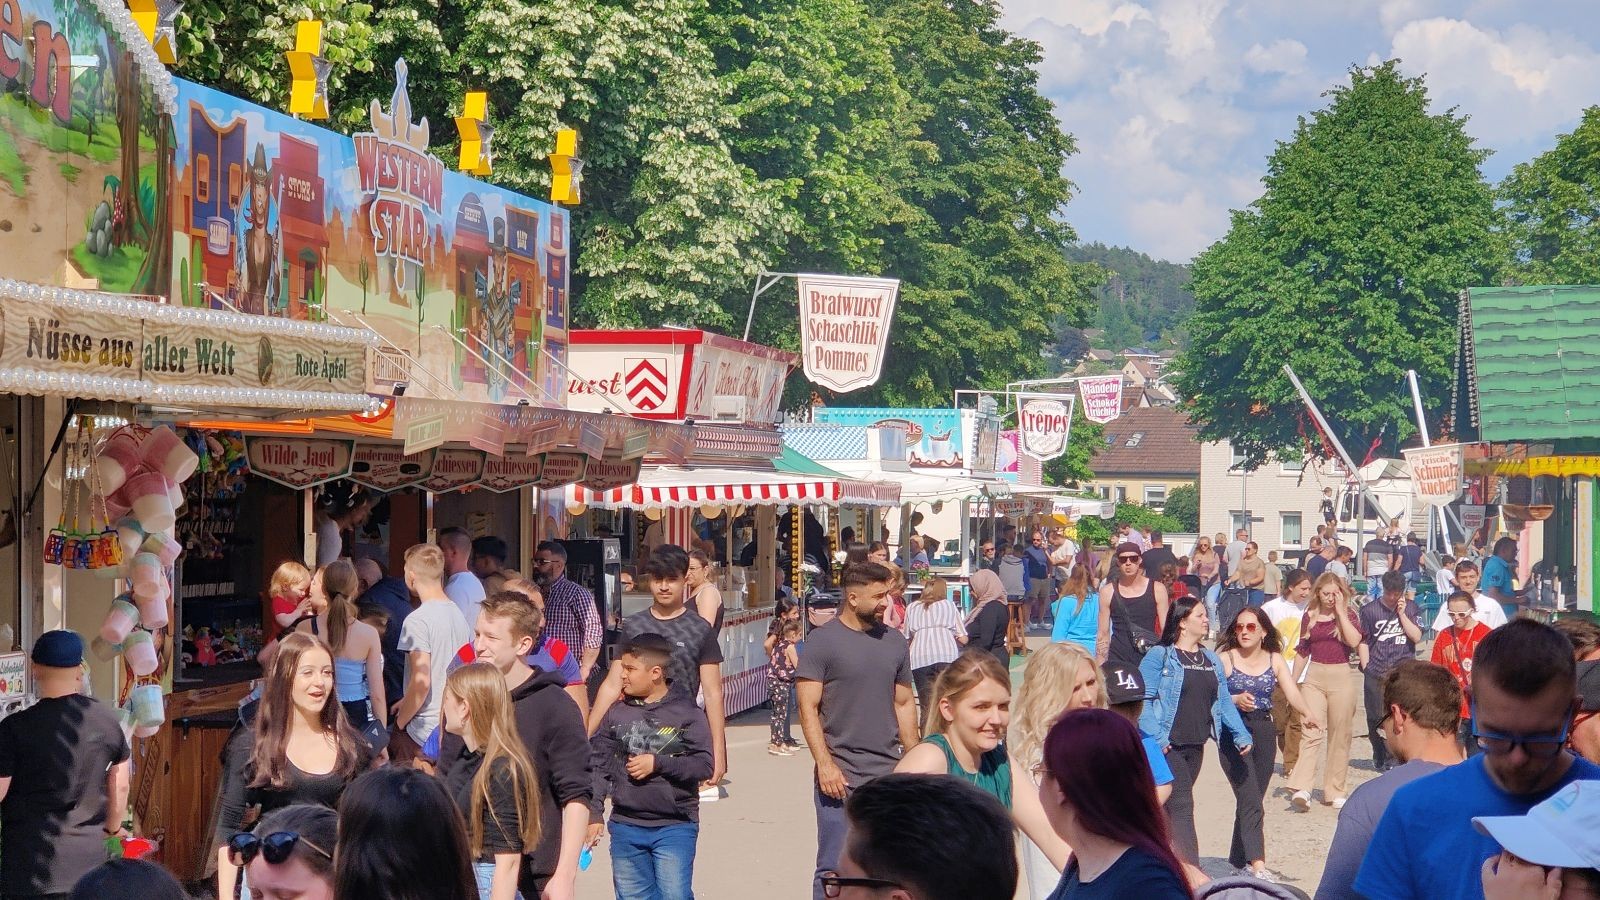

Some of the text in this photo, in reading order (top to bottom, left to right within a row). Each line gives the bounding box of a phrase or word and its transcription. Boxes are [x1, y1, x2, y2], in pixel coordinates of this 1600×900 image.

[355, 136, 443, 215] WESTERN
[374, 199, 424, 261] STAR
[810, 290, 882, 317] Bratwurst
[26, 316, 134, 368] Nüsse aus
[809, 318, 879, 345] Schaschlik
[144, 335, 236, 376] aller Welt
[295, 350, 347, 383] Rote Äpfel
[815, 345, 868, 372] Pommes
[568, 372, 622, 395] urst
[1021, 409, 1068, 436] Crêpes
[262, 445, 335, 468] Wilde Jagd
[486, 456, 538, 475] nschiessen
[1114, 669, 1140, 690] LA
